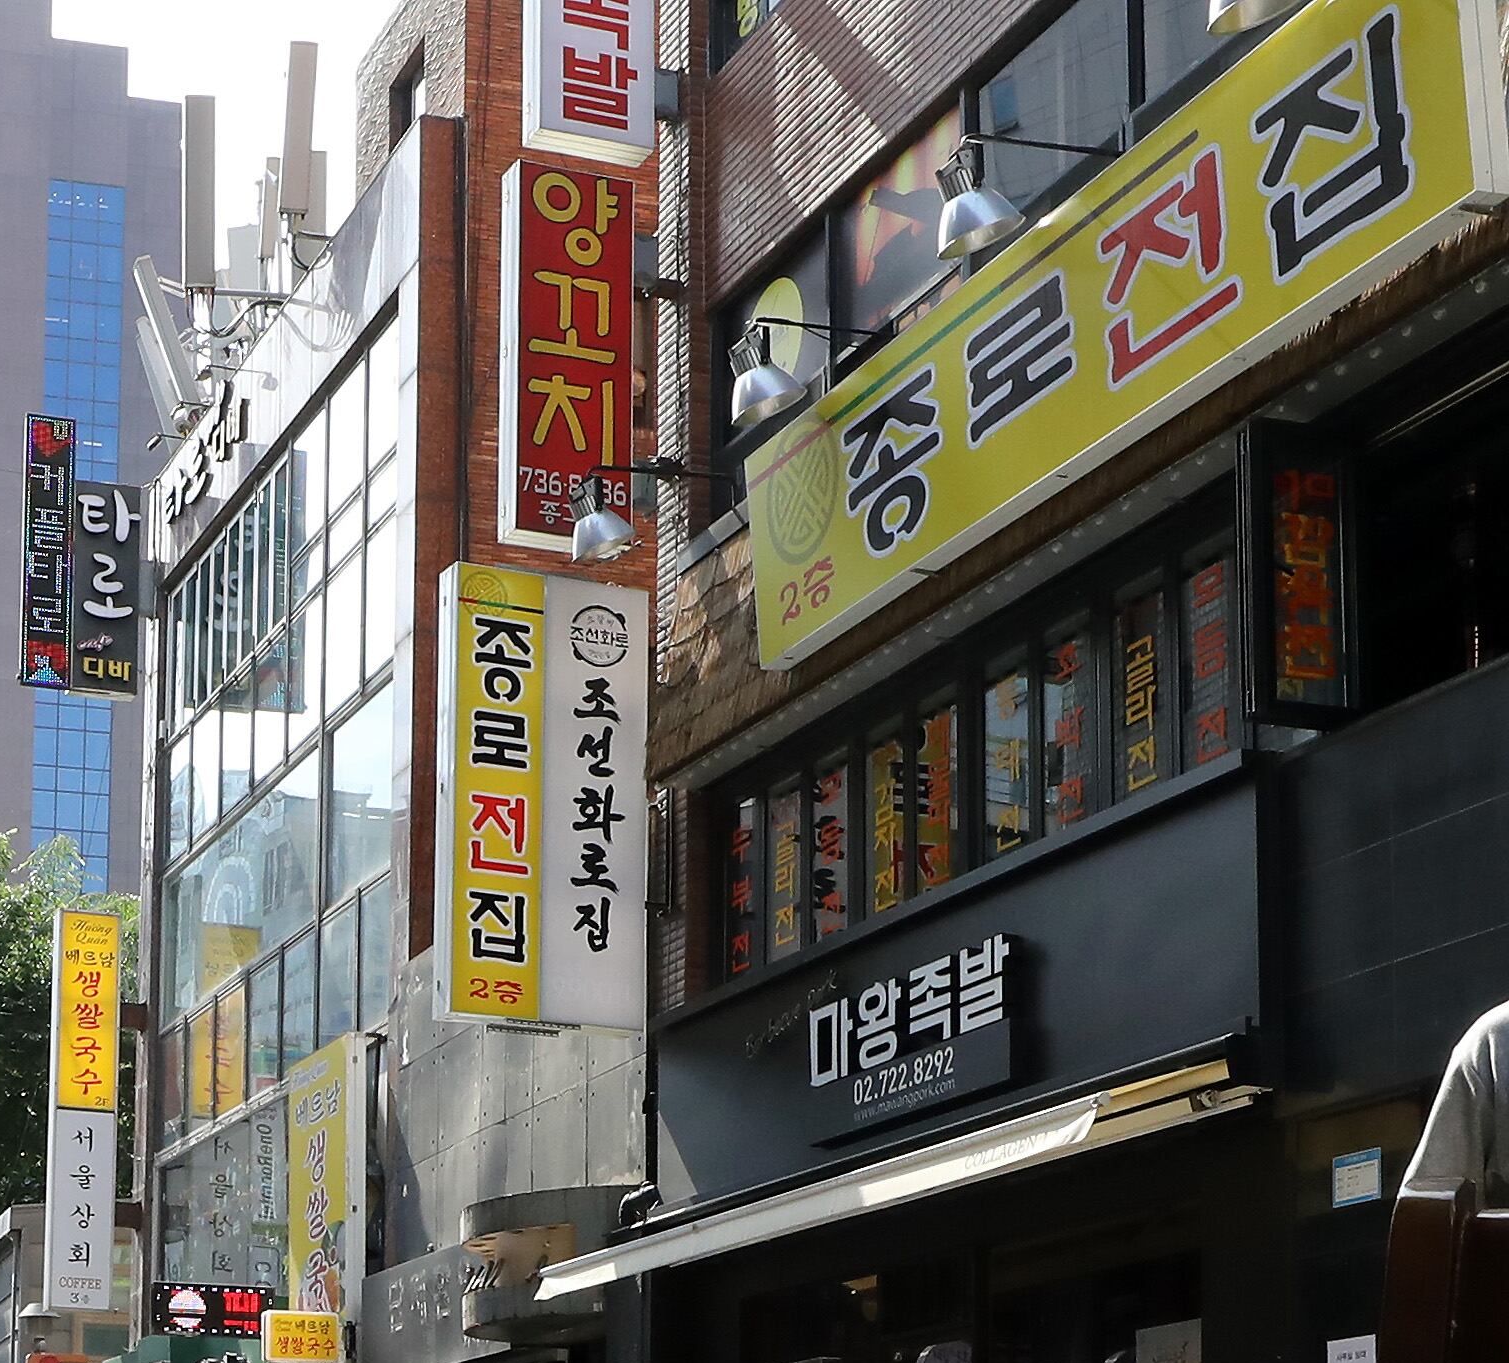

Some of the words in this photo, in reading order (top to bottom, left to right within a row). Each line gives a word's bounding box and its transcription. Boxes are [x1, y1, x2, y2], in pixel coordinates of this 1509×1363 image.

[527, 171, 618, 466] 양꼬치
[842, 12, 1414, 556] 종로전집
[78, 489, 143, 619] 타로
[779, 556, 836, 627] 2층
[570, 624, 630, 649] 조선화로
[468, 612, 532, 966] 종로전집
[570, 677, 626, 953] 조선화로집
[65, 949, 116, 970] 베트남
[469, 977, 524, 1005] 2층
[69, 970, 103, 1096] 생쌀국수
[809, 934, 1010, 1088] 마왕족발
[295, 1080, 342, 1126] 베트남
[853, 1046, 955, 1106] 02.722.8292
[68, 1128, 96, 1265] 서울상회
[59, 1276, 102, 1291] COFFEE
[276, 1335, 337, 1356] 생쌀국수
[295, 1319, 332, 1335] 베트남
